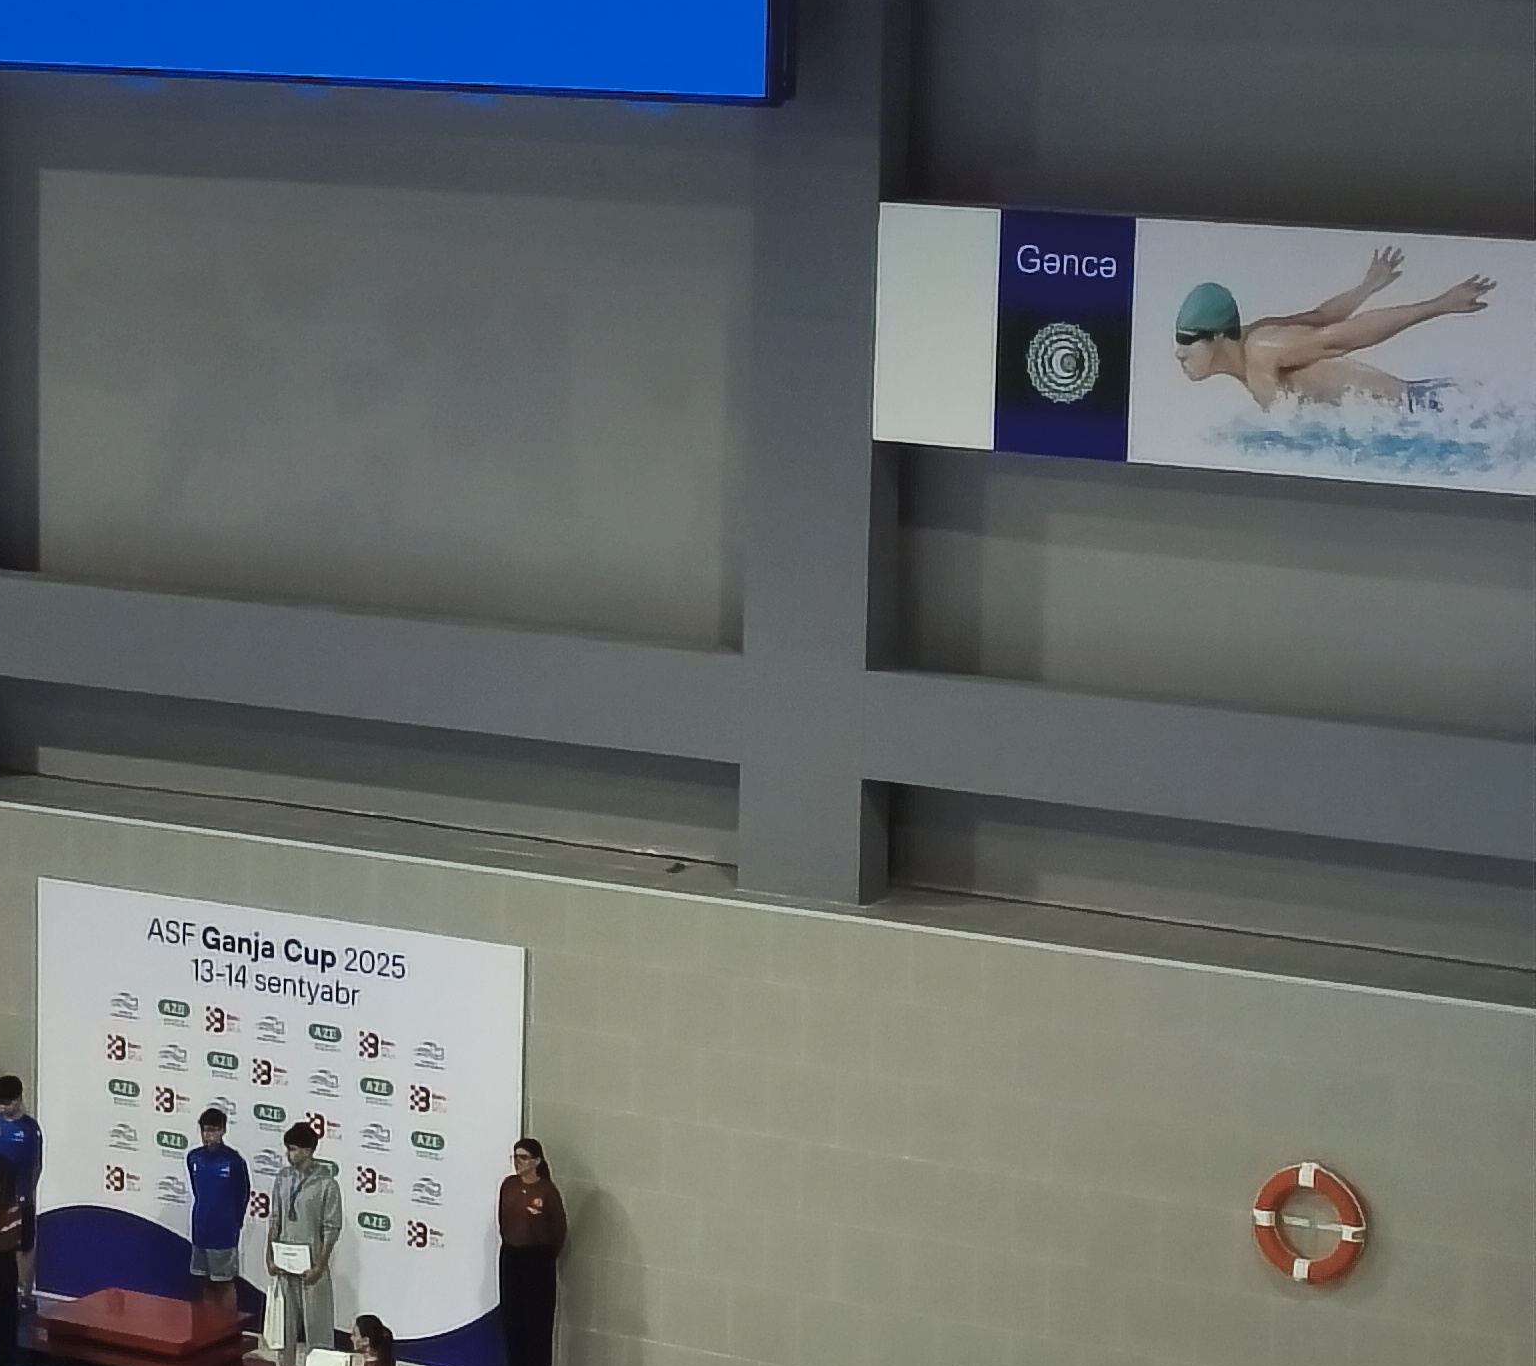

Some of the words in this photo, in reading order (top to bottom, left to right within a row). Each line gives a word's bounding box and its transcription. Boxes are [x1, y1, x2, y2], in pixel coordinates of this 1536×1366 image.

[1016, 244, 1118, 278] Gəncə
[147, 917, 196, 947] ASF
[201, 926, 275, 962] Ganja
[284, 938, 337, 974] Cup
[344, 947, 406, 980] 2025
[191, 958, 247, 989] 13-14
[254, 973, 361, 1007] sentyabr
